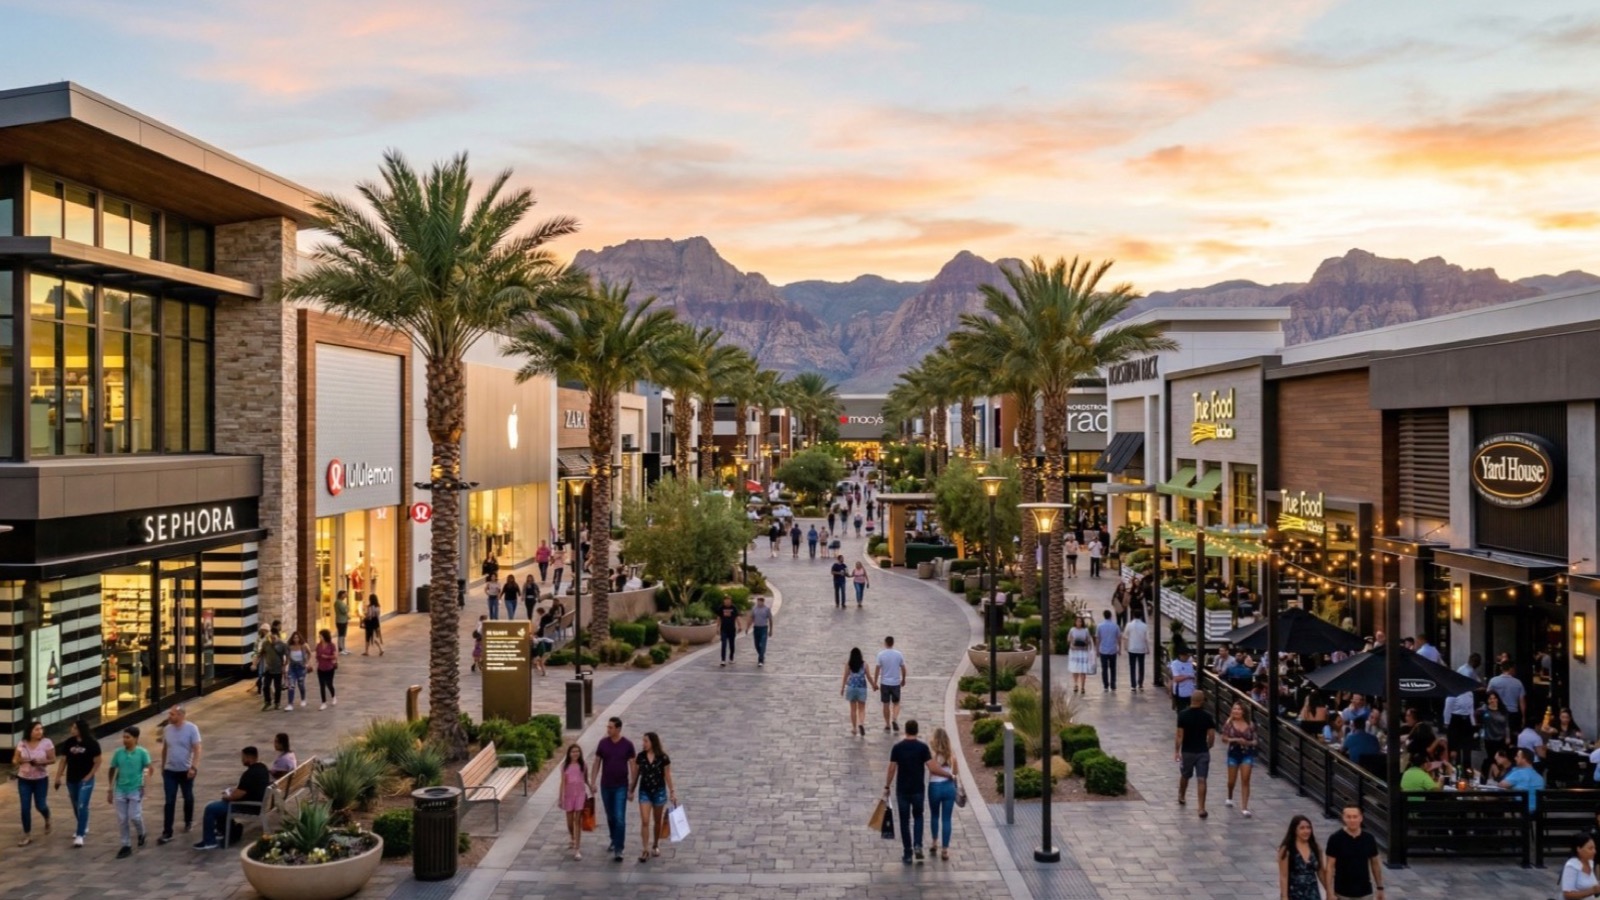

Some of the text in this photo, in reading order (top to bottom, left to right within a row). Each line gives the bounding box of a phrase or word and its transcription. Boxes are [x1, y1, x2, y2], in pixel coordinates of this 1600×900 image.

[1192, 388, 1234, 422] True Food
[564, 409, 589, 429] ZARA
[849, 413, 884, 426] macy's
[1067, 411, 1108, 432] rac
[344, 462, 394, 489] lululemon
[1481, 456, 1545, 483] Yard House
[1280, 489, 1323, 518] True Food
[145, 506, 235, 543] SEPHORA
